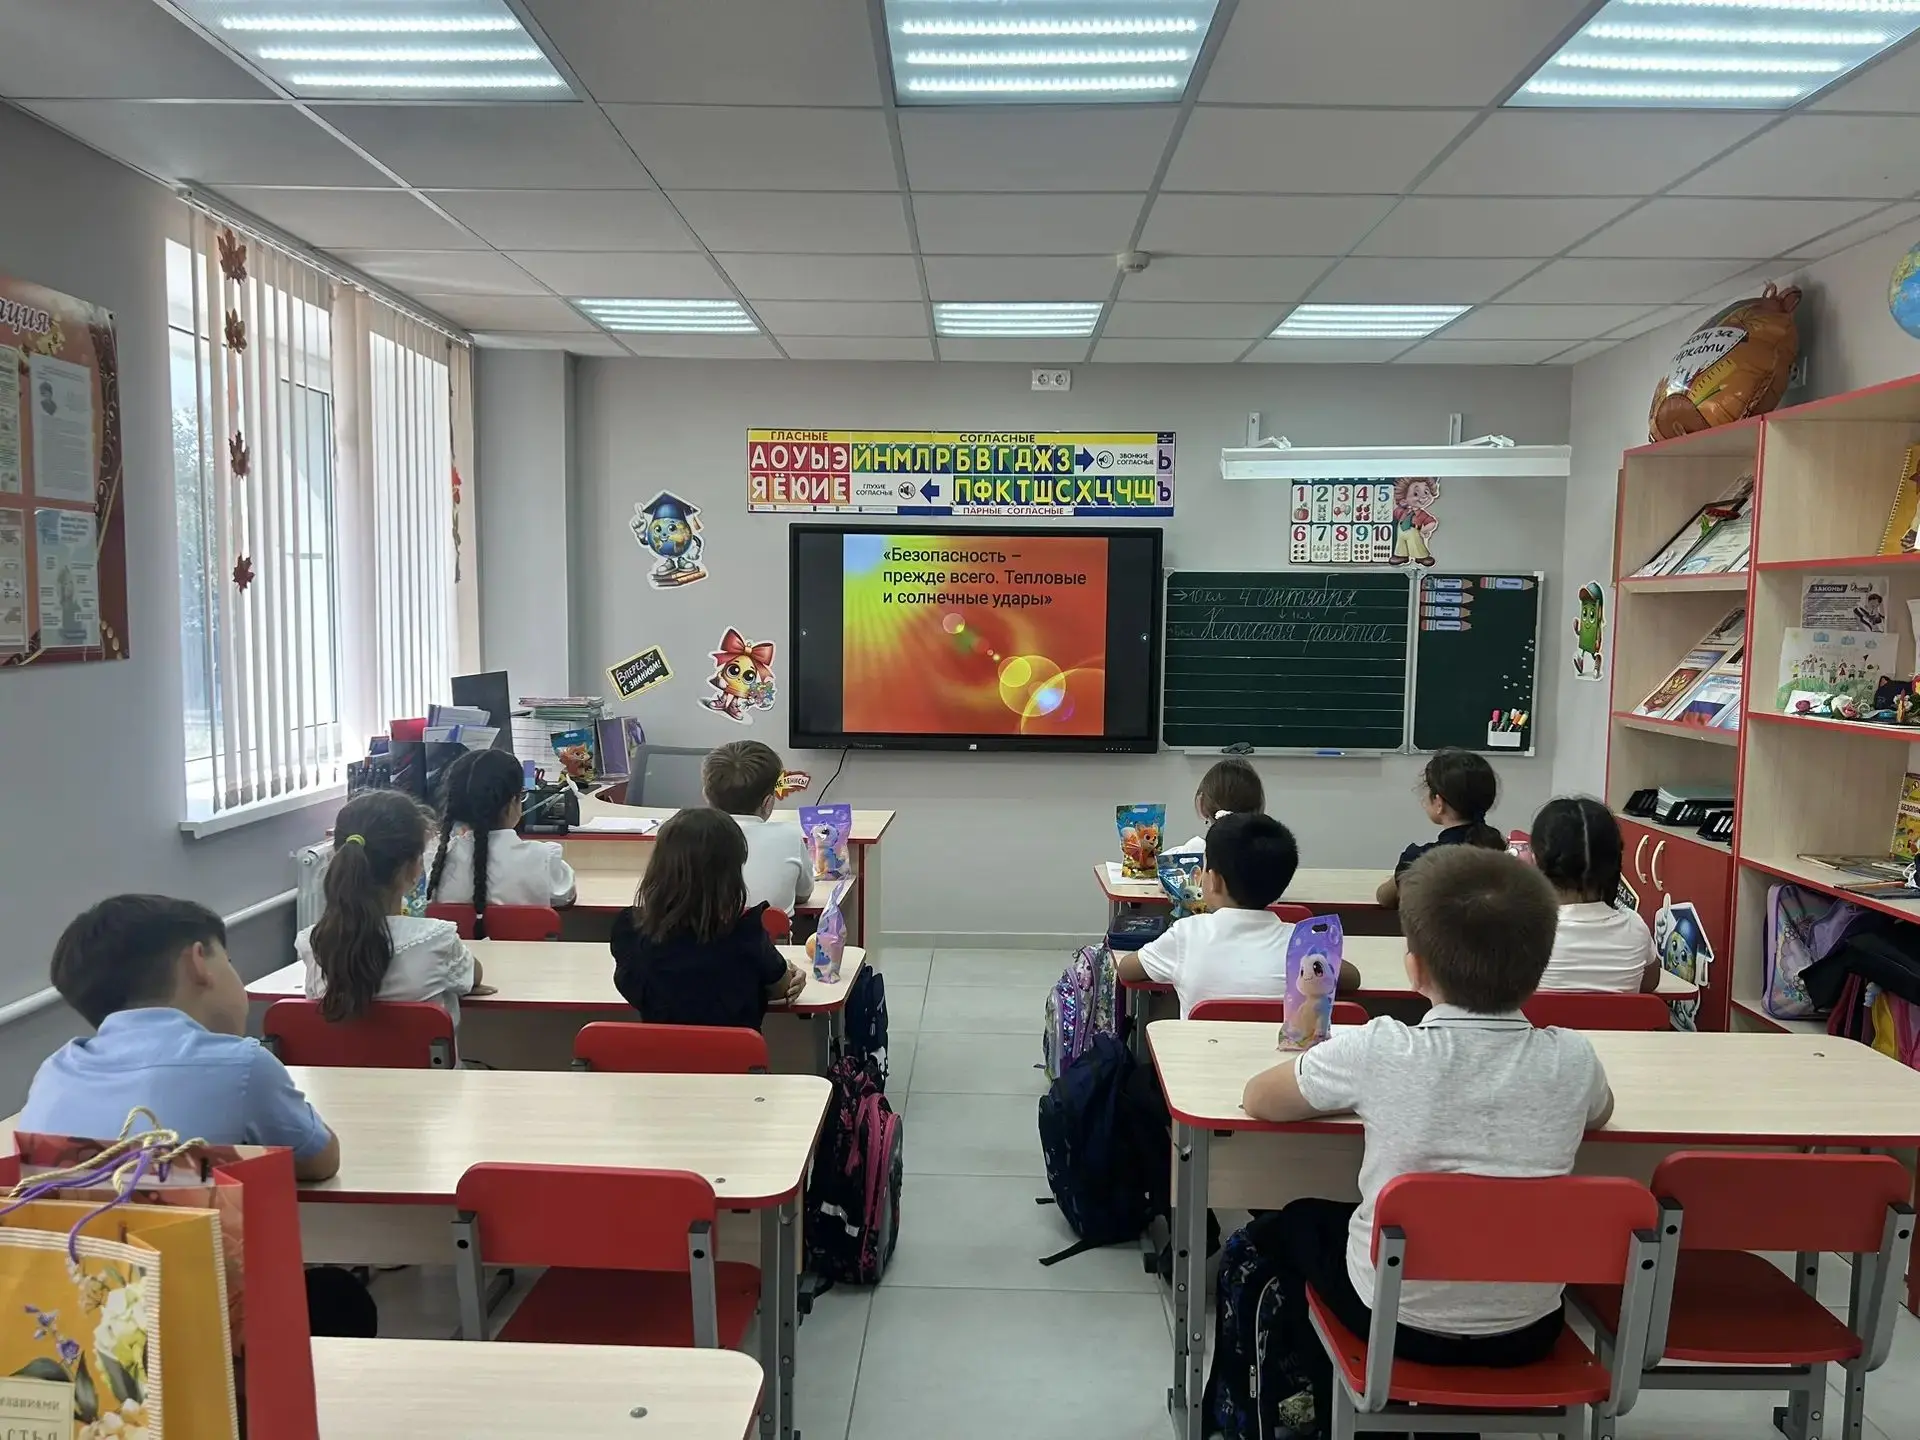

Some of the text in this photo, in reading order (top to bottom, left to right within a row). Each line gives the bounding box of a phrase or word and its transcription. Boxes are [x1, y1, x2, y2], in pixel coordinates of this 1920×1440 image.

[770, 431, 829, 441] ГЛАСНЫЕ
[959, 433, 1036, 443] СОГЛАСНЫЕ
[1297, 486, 1390, 502] 1 2 3 4 5
[963, 507, 1064, 515] ПАРНЫЕ СОГЛАСНЫЕ
[1293, 525, 1392, 541] 6 7 8 9 10
[883, 547, 1006, 563] «Безопасность
[883, 570, 1086, 585] прежде всего. Тепловые
[883, 593, 1052, 607] и солнечные удары»
[1256, 573, 1357, 616] сентября
[1200, 606, 1297, 641] Классная
[1303, 611, 1392, 655] работа
[628, 659, 662, 689] ЗНАНИЯМ!
